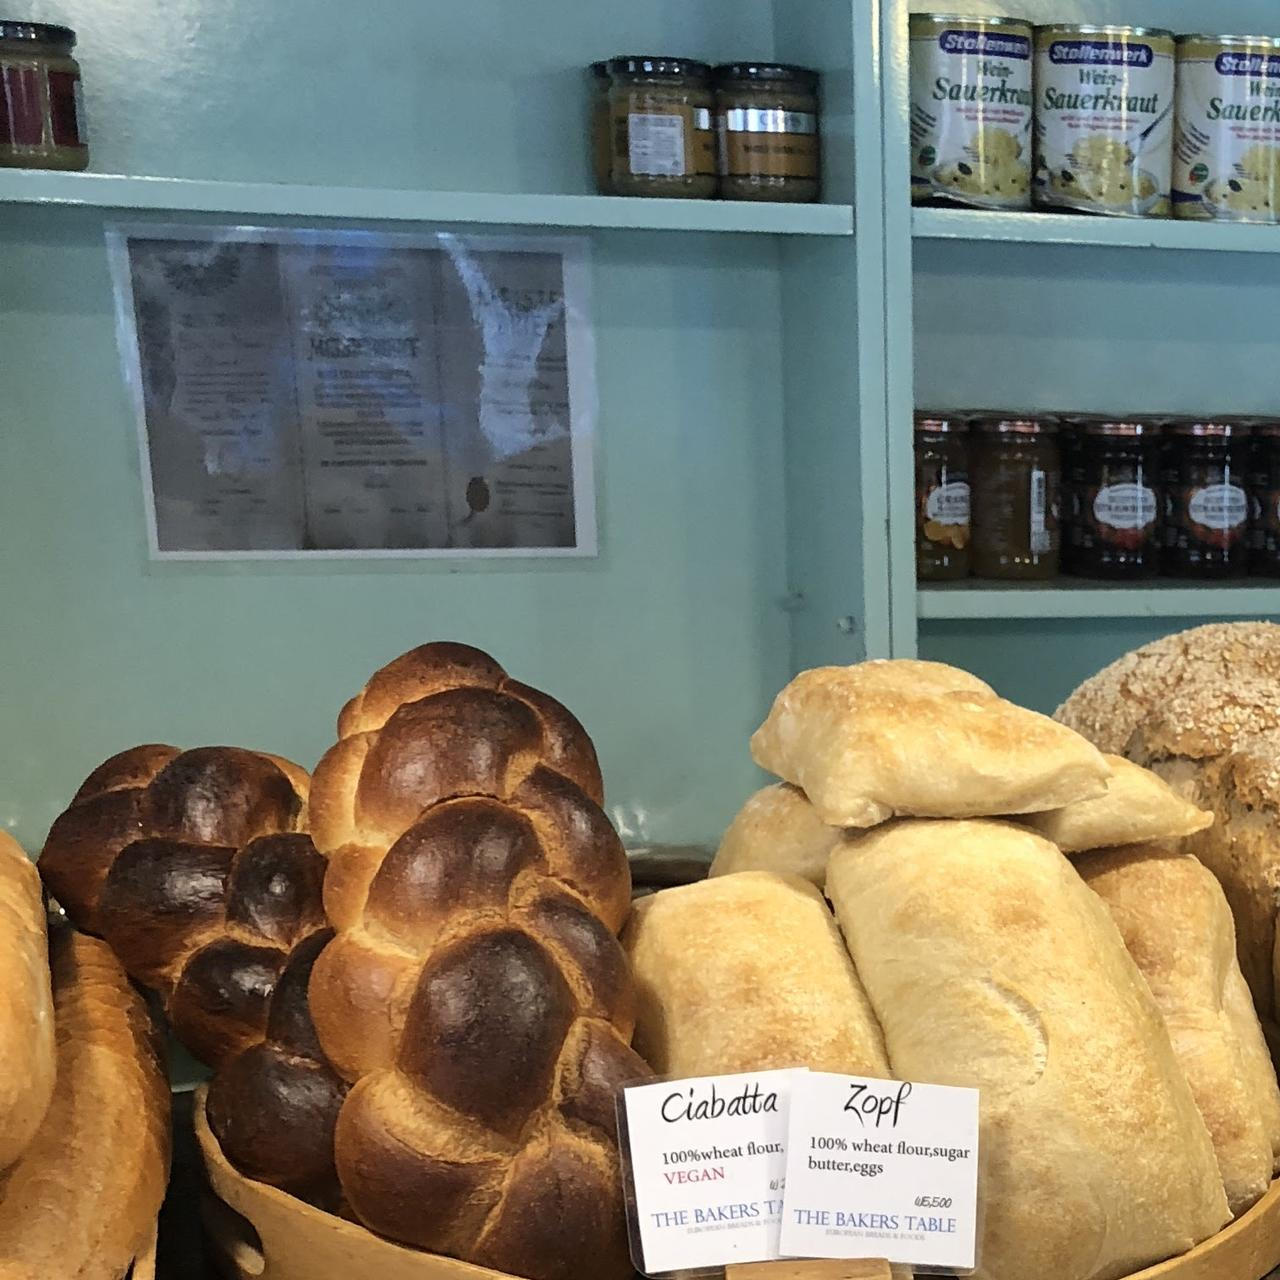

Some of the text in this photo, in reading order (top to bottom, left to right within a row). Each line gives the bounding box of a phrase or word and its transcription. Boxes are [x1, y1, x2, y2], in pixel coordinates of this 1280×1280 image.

[1052, 44, 1150, 63] Stollenwerk
[932, 77, 1031, 106] Sauerkra
[1044, 87, 1159, 115] Sauerkraut
[660, 1082, 778, 1123] Ciabatta
[843, 1081, 912, 1128] Zopf
[747, 1142, 785, 1156] flour,
[809, 1136, 971, 1161] 100% wheat flour,sugar
[663, 1166, 726, 1185] VEGAN
[808, 1155, 884, 1177] butter,eggs
[651, 1210, 688, 1228] THE
[694, 1202, 760, 1224] BAKERS
[793, 1209, 831, 1226] THE
[835, 1211, 899, 1230] BAKERS
[904, 1215, 957, 1234] TABLE
